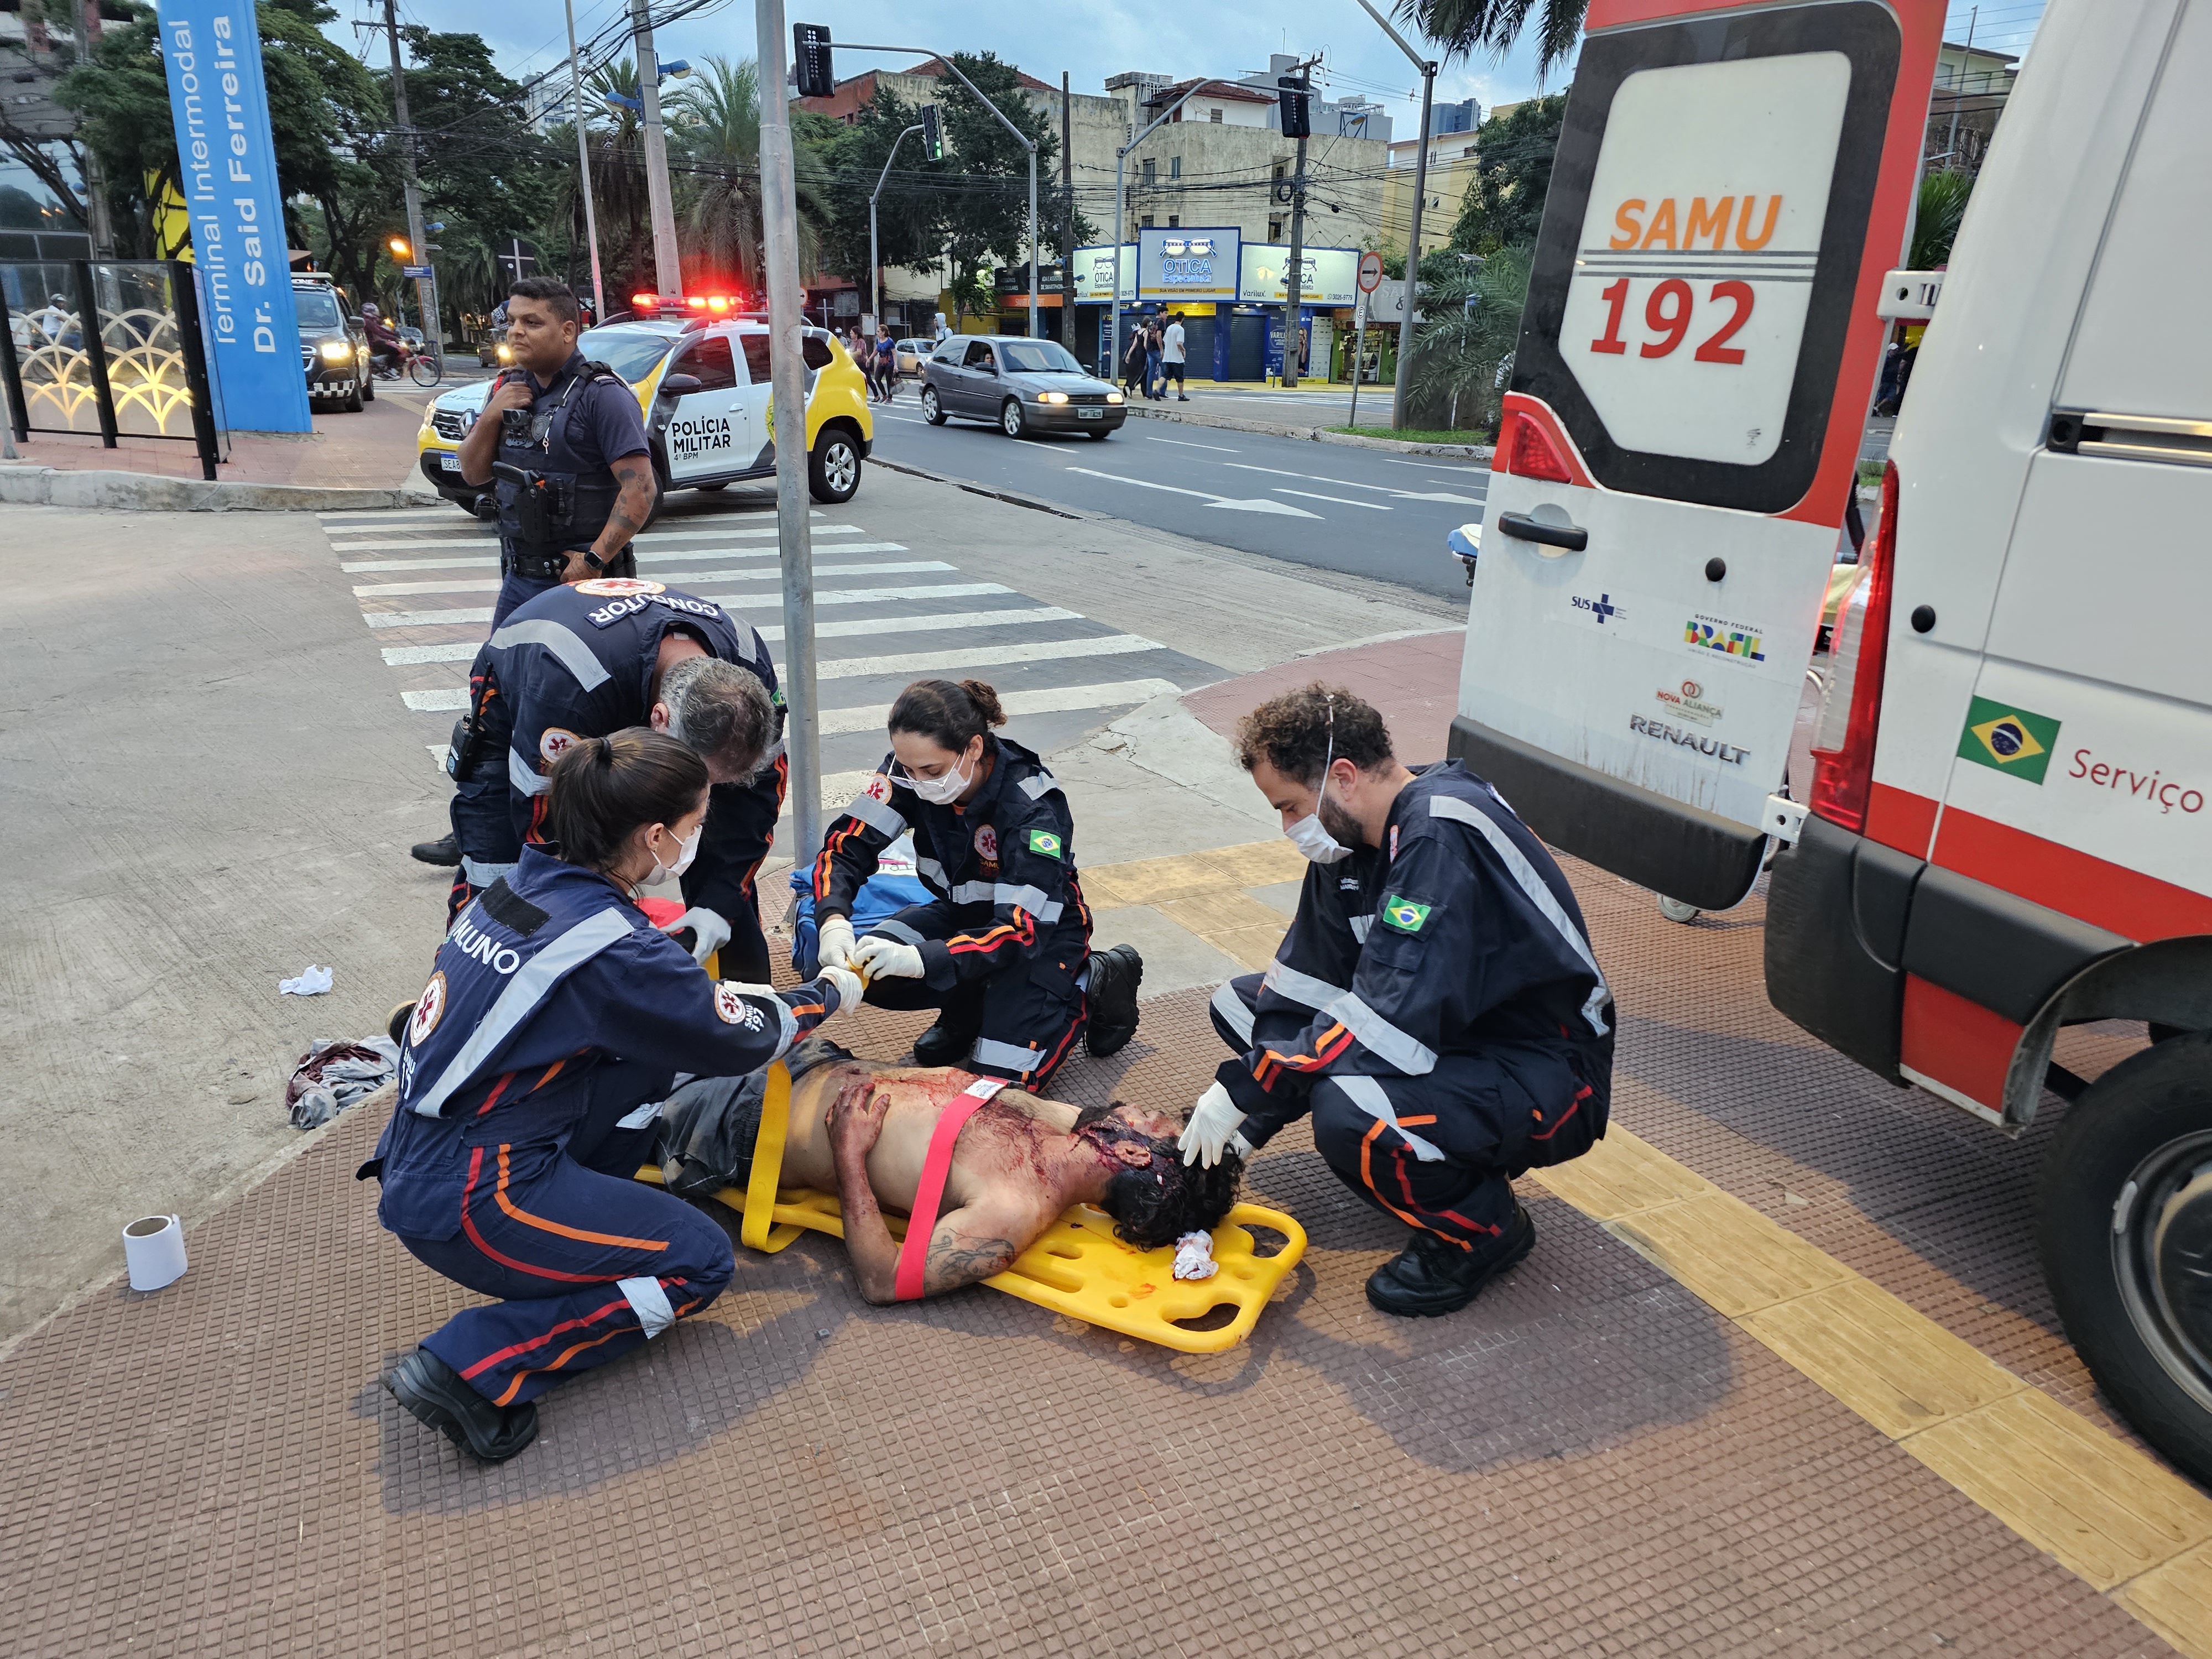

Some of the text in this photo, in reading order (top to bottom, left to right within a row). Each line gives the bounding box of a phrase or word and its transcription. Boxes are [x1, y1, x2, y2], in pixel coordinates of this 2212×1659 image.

[168, 20, 236, 343] Terminal Intermodal
[213, 15, 276, 353] Dr. Said Ferreira
[1609, 194, 1782, 251] SAMU
[1095, 270, 1113, 283] ÓTICA
[1163, 255, 1212, 274] ÓTICA
[1162, 273, 1212, 284] Especialista
[1590, 278, 1755, 365] 192
[672, 415, 731, 437] POLÍCIA
[674, 434, 731, 453] MILITAR
[683, 452, 698, 460] BPM
[588, 594, 719, 623] CONDUTOR
[1571, 596, 1590, 610] SUS
[1694, 614, 1764, 634] GOVERNO FEDERAL
[1684, 620, 1765, 662] BRASIL
[1657, 691, 1681, 704] NOVA
[1683, 698, 1723, 717] ALIANÇA
[1630, 712, 1751, 765] RENAULT
[2069, 749, 2204, 814] Serviço
[453, 919, 520, 974] ALUNO
[744, 1004, 754, 1028] SAMU
